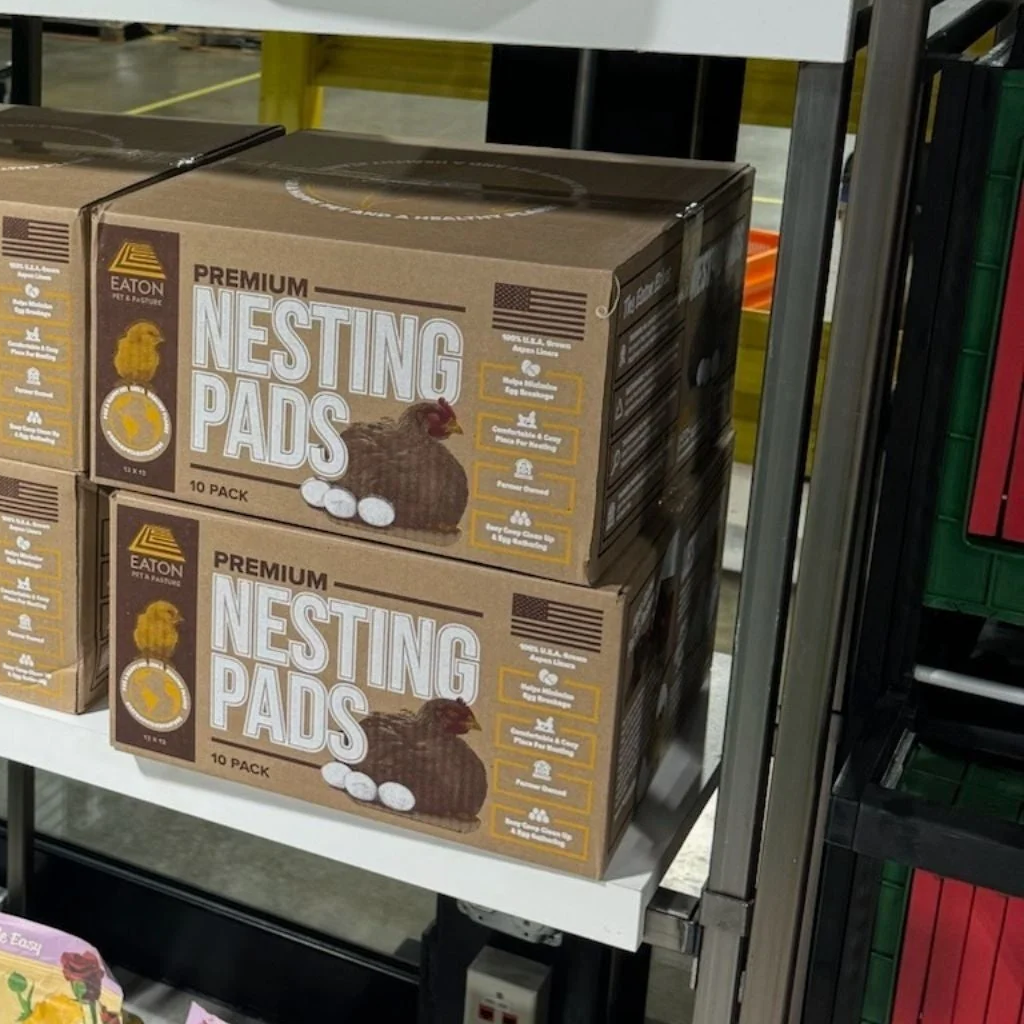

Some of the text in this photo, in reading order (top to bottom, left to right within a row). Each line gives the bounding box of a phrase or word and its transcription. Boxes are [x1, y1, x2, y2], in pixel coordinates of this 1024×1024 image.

[110, 276, 165, 297] EATON
[193, 264, 308, 298] PREMIUM
[112, 293, 163, 306] PET & PASTURE
[190, 284, 464, 407] NESTING
[189, 369, 350, 480] PADS
[190, 480, 249, 503] 10 PACK
[129, 555, 184, 578] EATON
[131, 570, 144, 580] PET
[150, 574, 181, 587] PASTURE
[213, 550, 328, 591] PREMIUM
[210, 572, 481, 707] NESTING
[209, 652, 369, 765] PADS
[211, 753, 270, 778] 10 PACK
[10, 932, 43, 957] Easy
